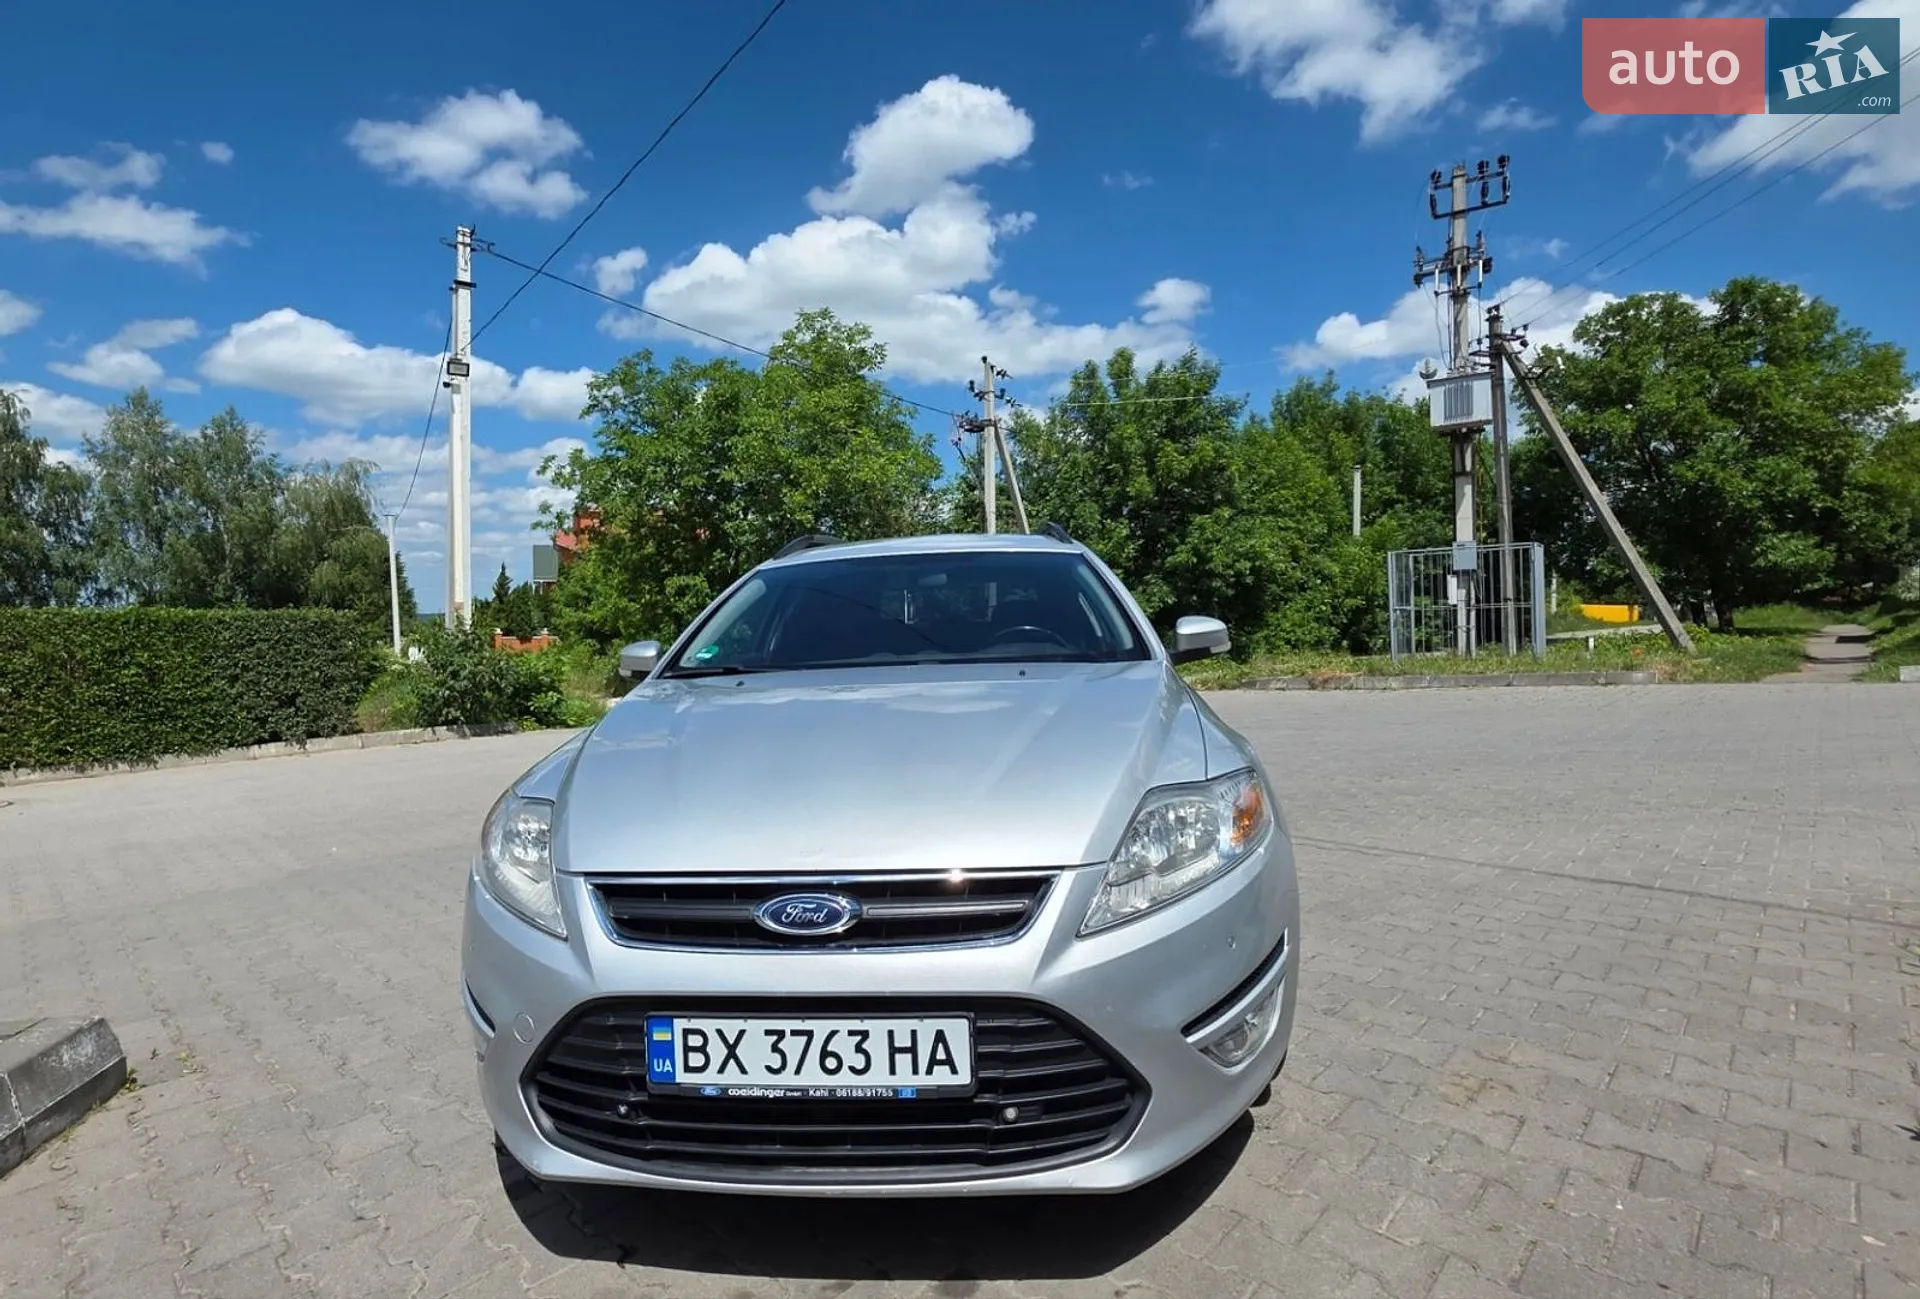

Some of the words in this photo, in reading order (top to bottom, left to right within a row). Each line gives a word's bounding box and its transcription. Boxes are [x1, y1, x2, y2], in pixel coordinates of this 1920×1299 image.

[781, 902, 829, 923] Ford
[682, 1028, 748, 1075] BX
[764, 1029, 872, 1076] 3763
[887, 1029, 959, 1076] HA
[653, 1058, 673, 1073] UA
